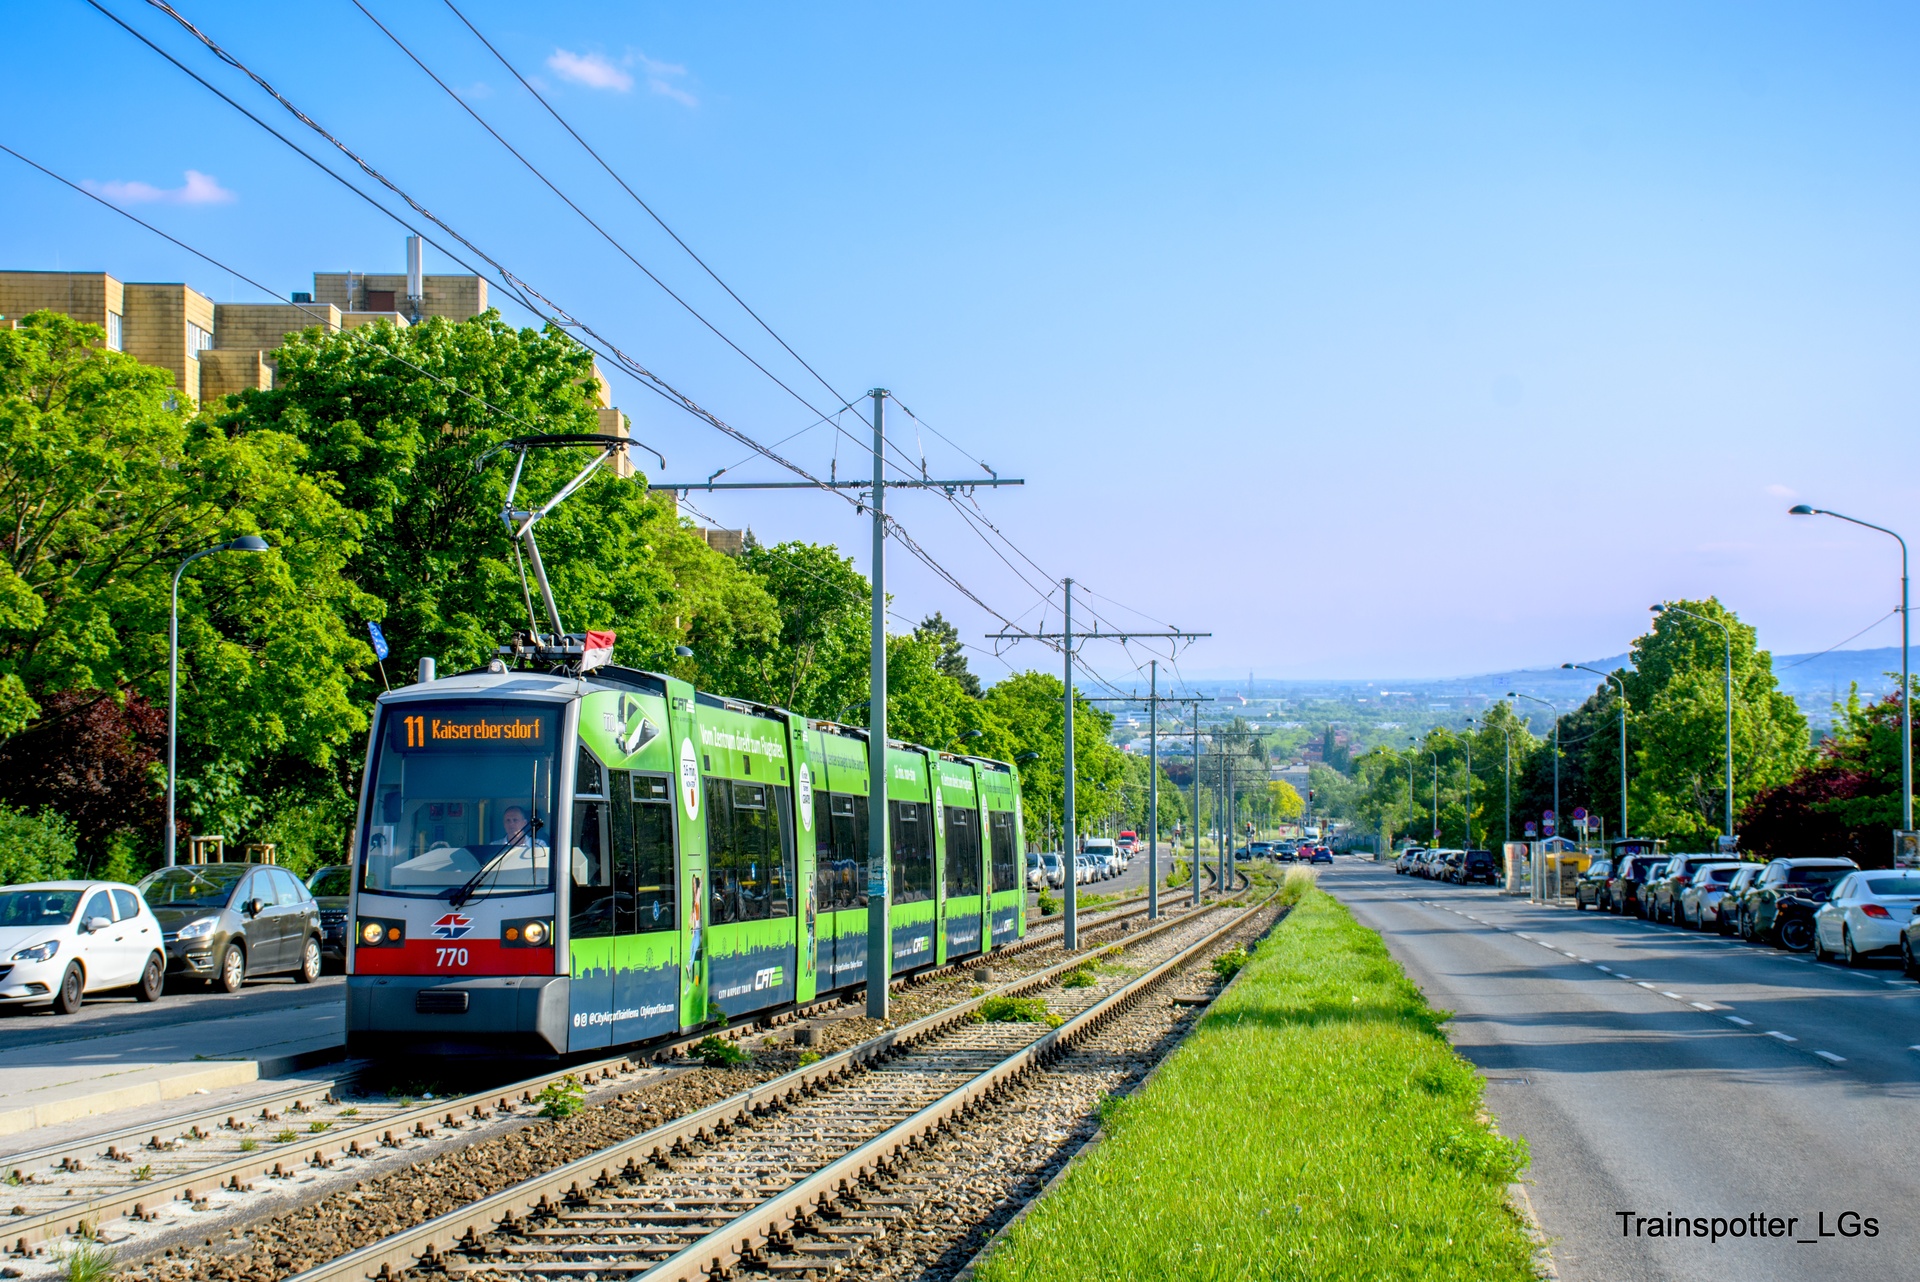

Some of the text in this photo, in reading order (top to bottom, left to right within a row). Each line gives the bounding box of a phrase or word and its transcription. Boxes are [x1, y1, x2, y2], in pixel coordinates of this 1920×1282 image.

[404, 715, 540, 747] 11 Kaiserebersdorf
[700, 723, 713, 746] Vom
[713, 726, 736, 750] Zentrum
[751, 738, 761, 754] zum
[436, 947, 469, 967] 770
[727, 985, 741, 998] AIRPORT
[755, 967, 776, 991] CAT
